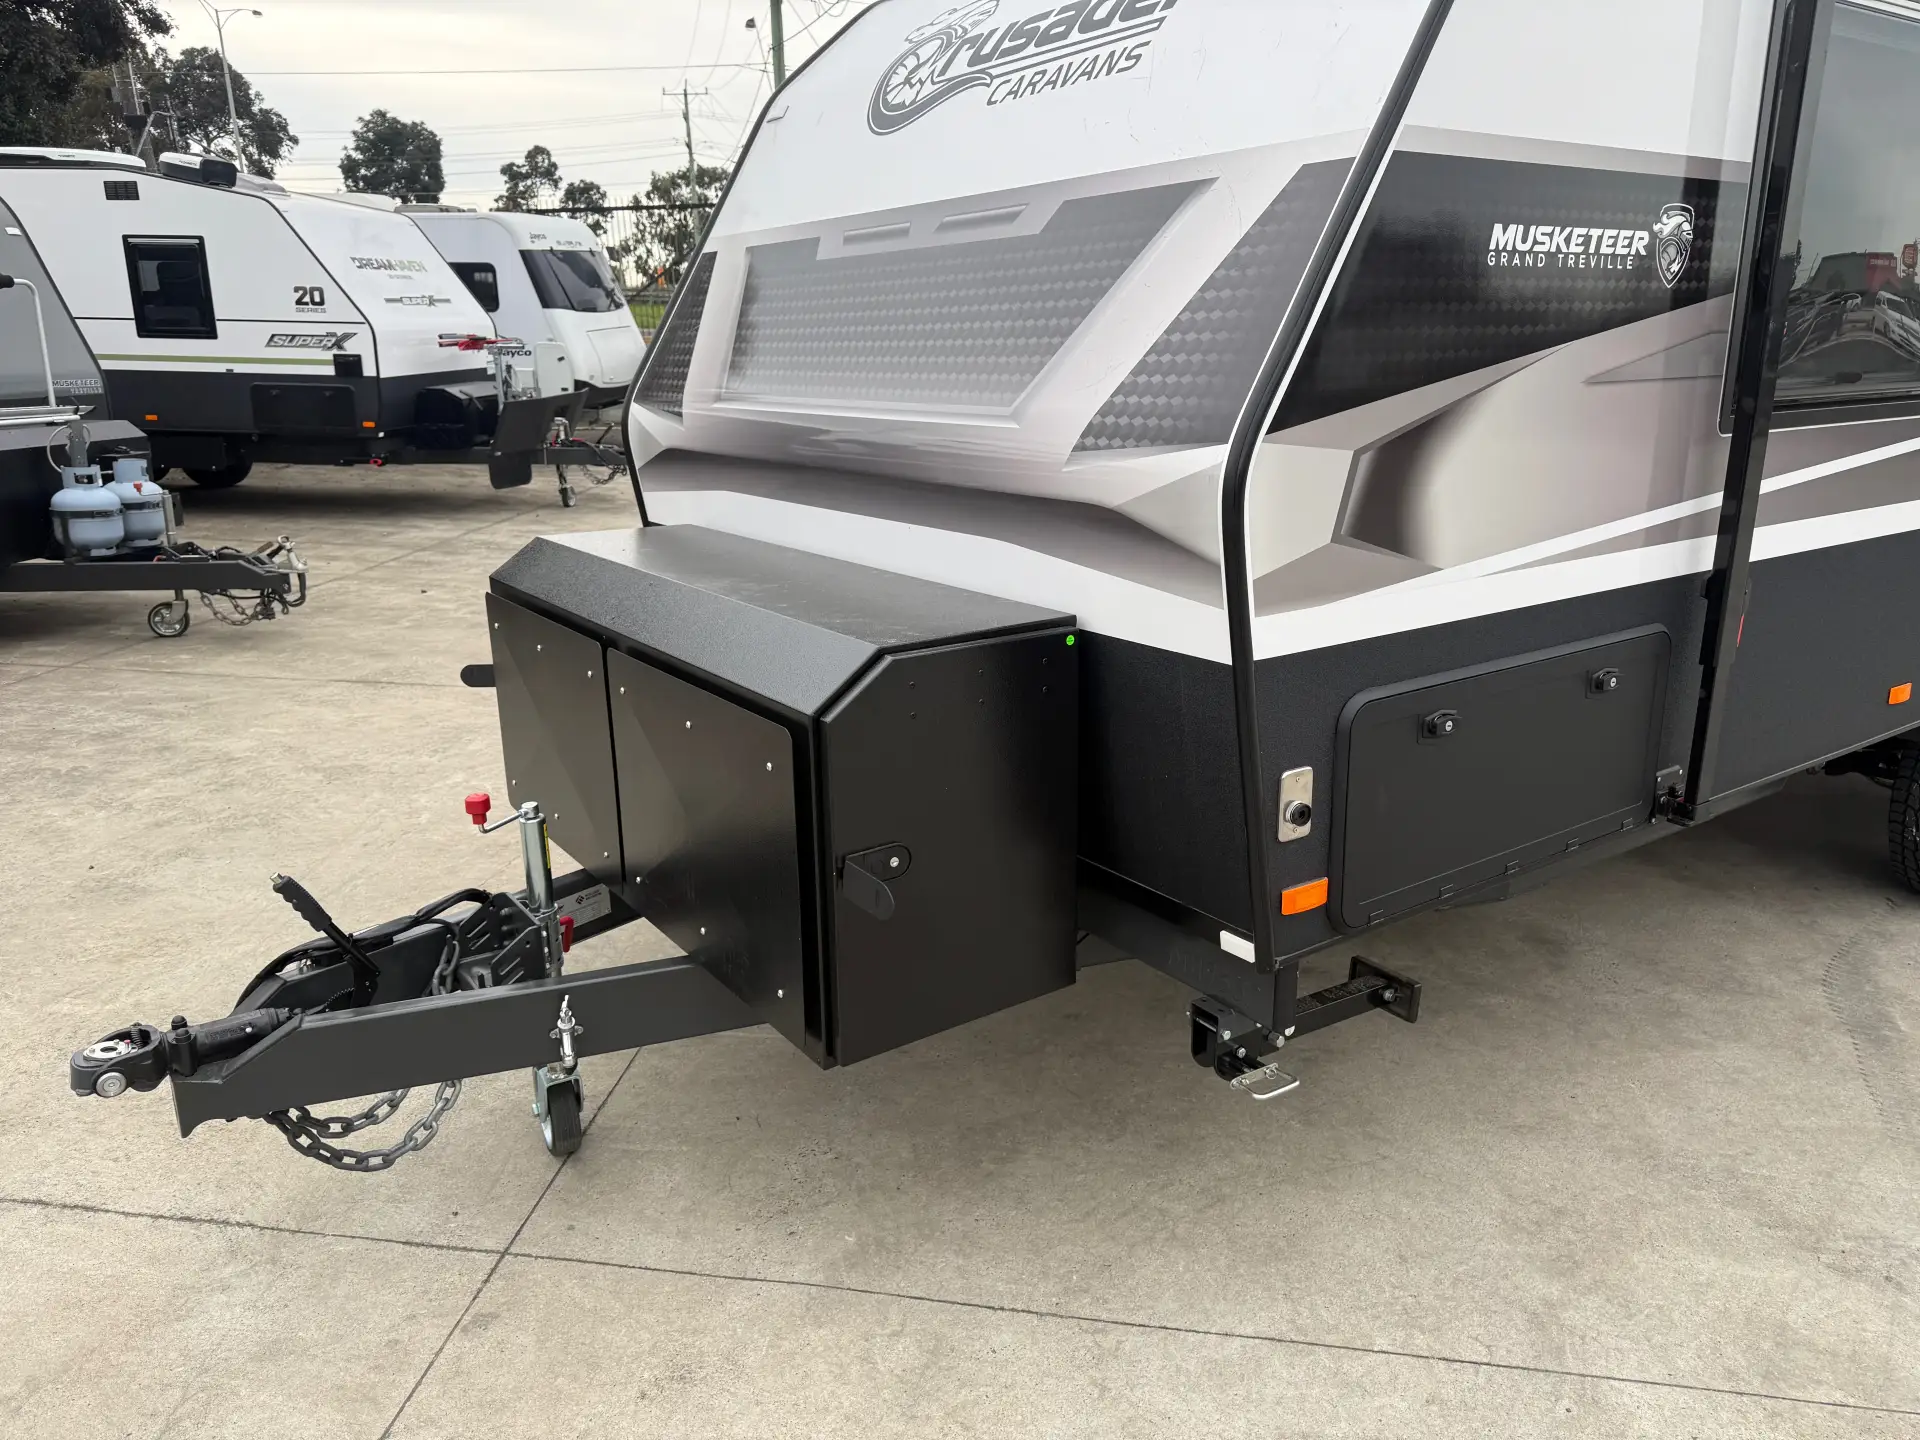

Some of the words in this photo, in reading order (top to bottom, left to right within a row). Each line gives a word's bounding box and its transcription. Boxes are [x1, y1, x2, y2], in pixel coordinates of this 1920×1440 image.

[986, 40, 1152, 107] CARAVANS
[1488, 223, 1650, 256] MUSKETEER
[1487, 251, 1546, 268] GRAND
[1557, 253, 1635, 270] TREVILLE
[293, 285, 326, 307] 20
[498, 349, 533, 358] ayco
[52, 379, 100, 387] MUSKETEER
